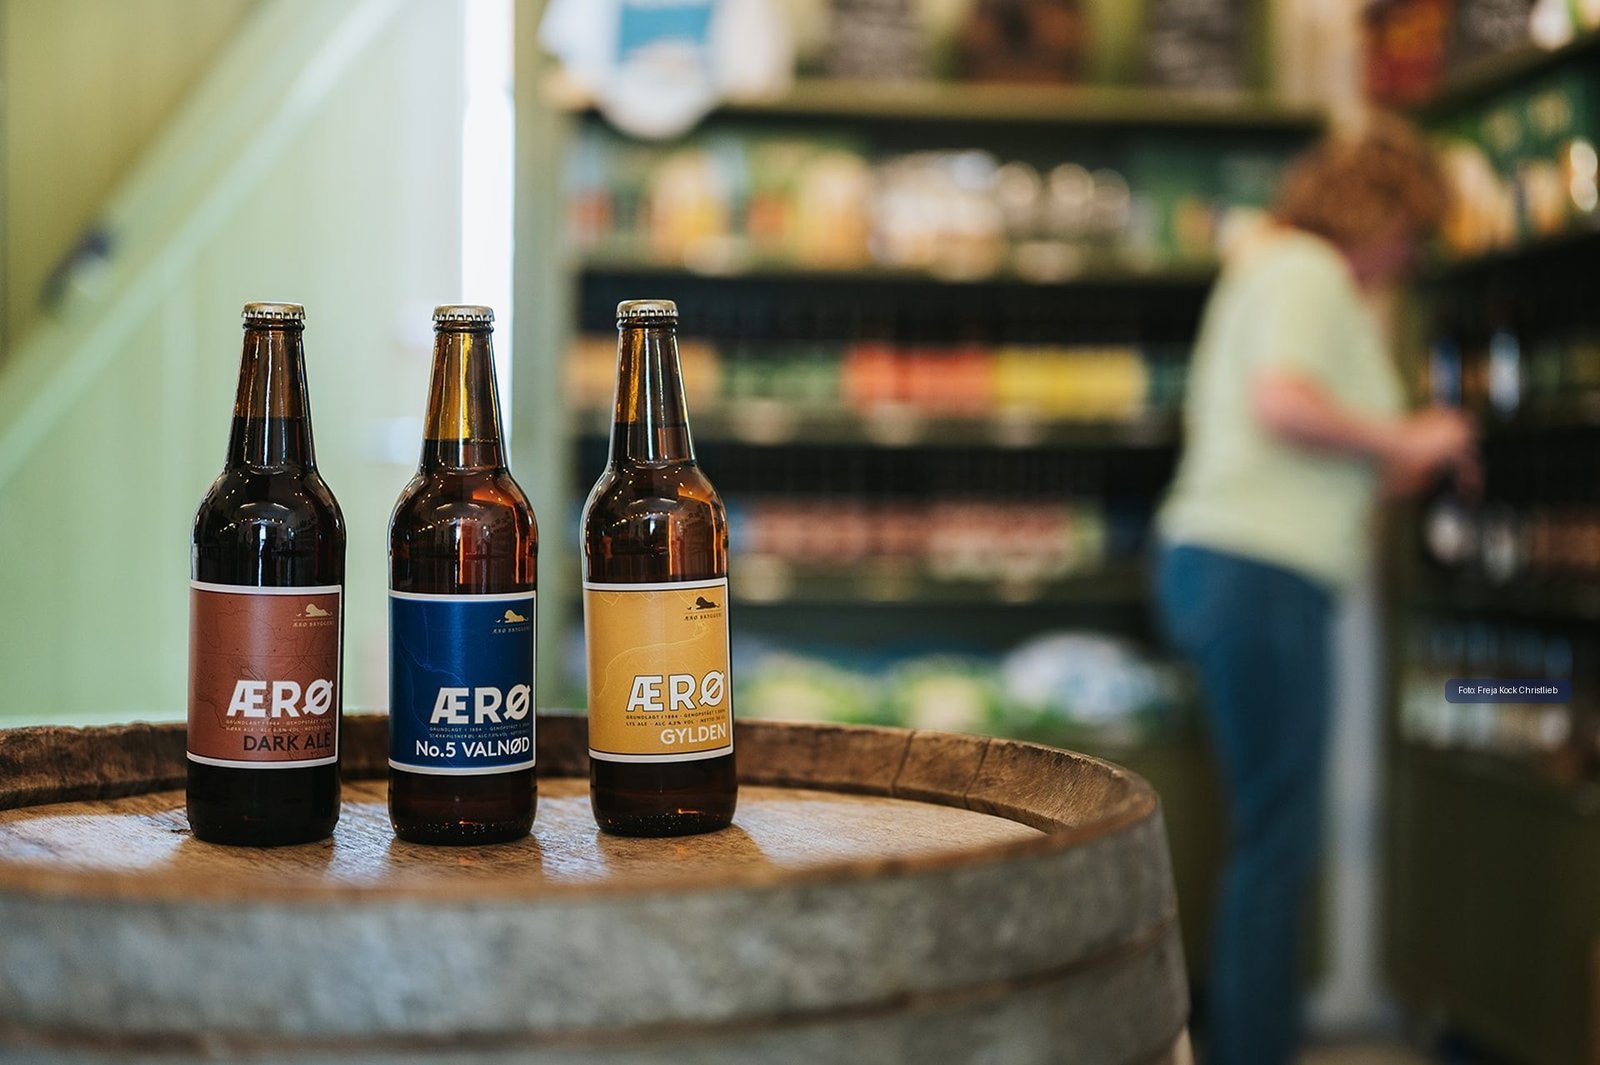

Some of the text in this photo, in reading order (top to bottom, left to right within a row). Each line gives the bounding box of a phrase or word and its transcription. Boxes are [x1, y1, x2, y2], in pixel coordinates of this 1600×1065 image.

[226, 679, 334, 718] ÆRØ
[430, 684, 531, 724] ÆRØ
[626, 670, 725, 712] ÆRØ
[244, 732, 331, 752] DARK ALE
[416, 736, 530, 758] No.5 VALNØD
[660, 723, 727, 745] GYLDEN
